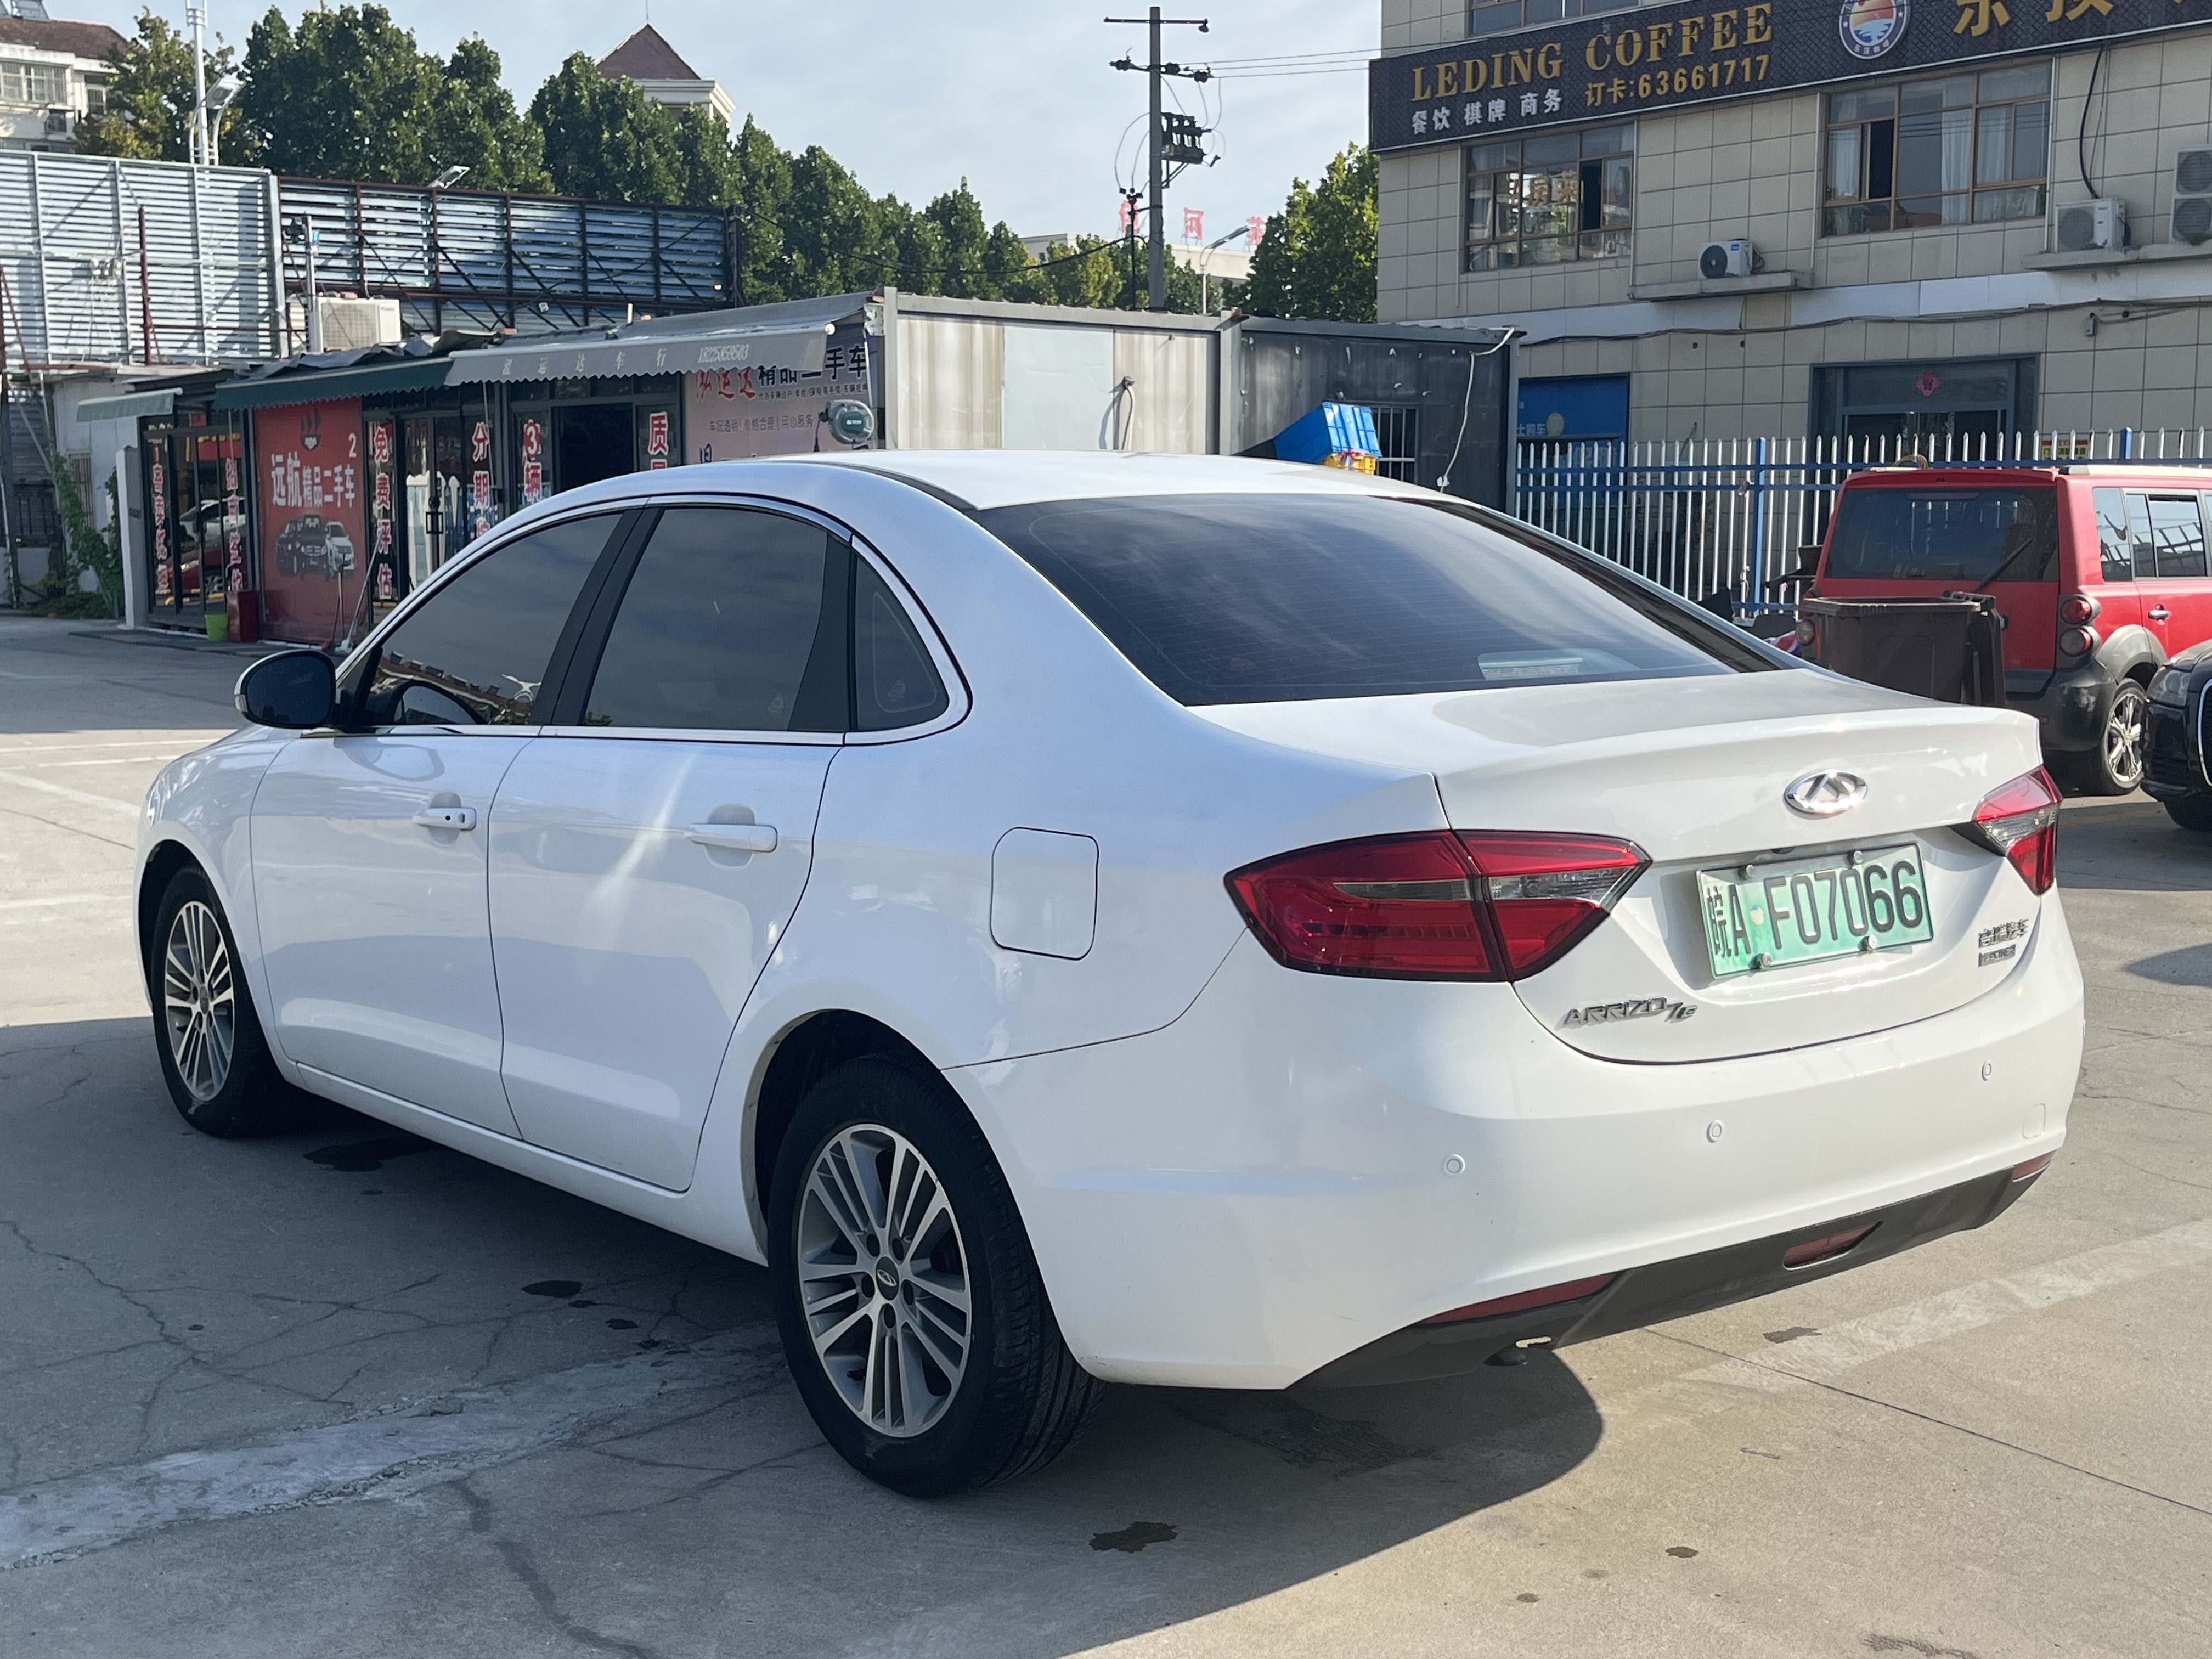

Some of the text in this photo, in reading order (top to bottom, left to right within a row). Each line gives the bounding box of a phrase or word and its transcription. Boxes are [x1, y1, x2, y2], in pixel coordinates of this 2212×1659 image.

[1412, 42, 1563, 101] LEDING
[1585, 3, 1771, 71] COFFEE
[1412, 88, 1562, 135] 餐饮 棋牌 商务
[348, 432, 357, 458] 2
[272, 450, 356, 509] 远航精品二手车
[1763, 860, 1923, 950] F07066
